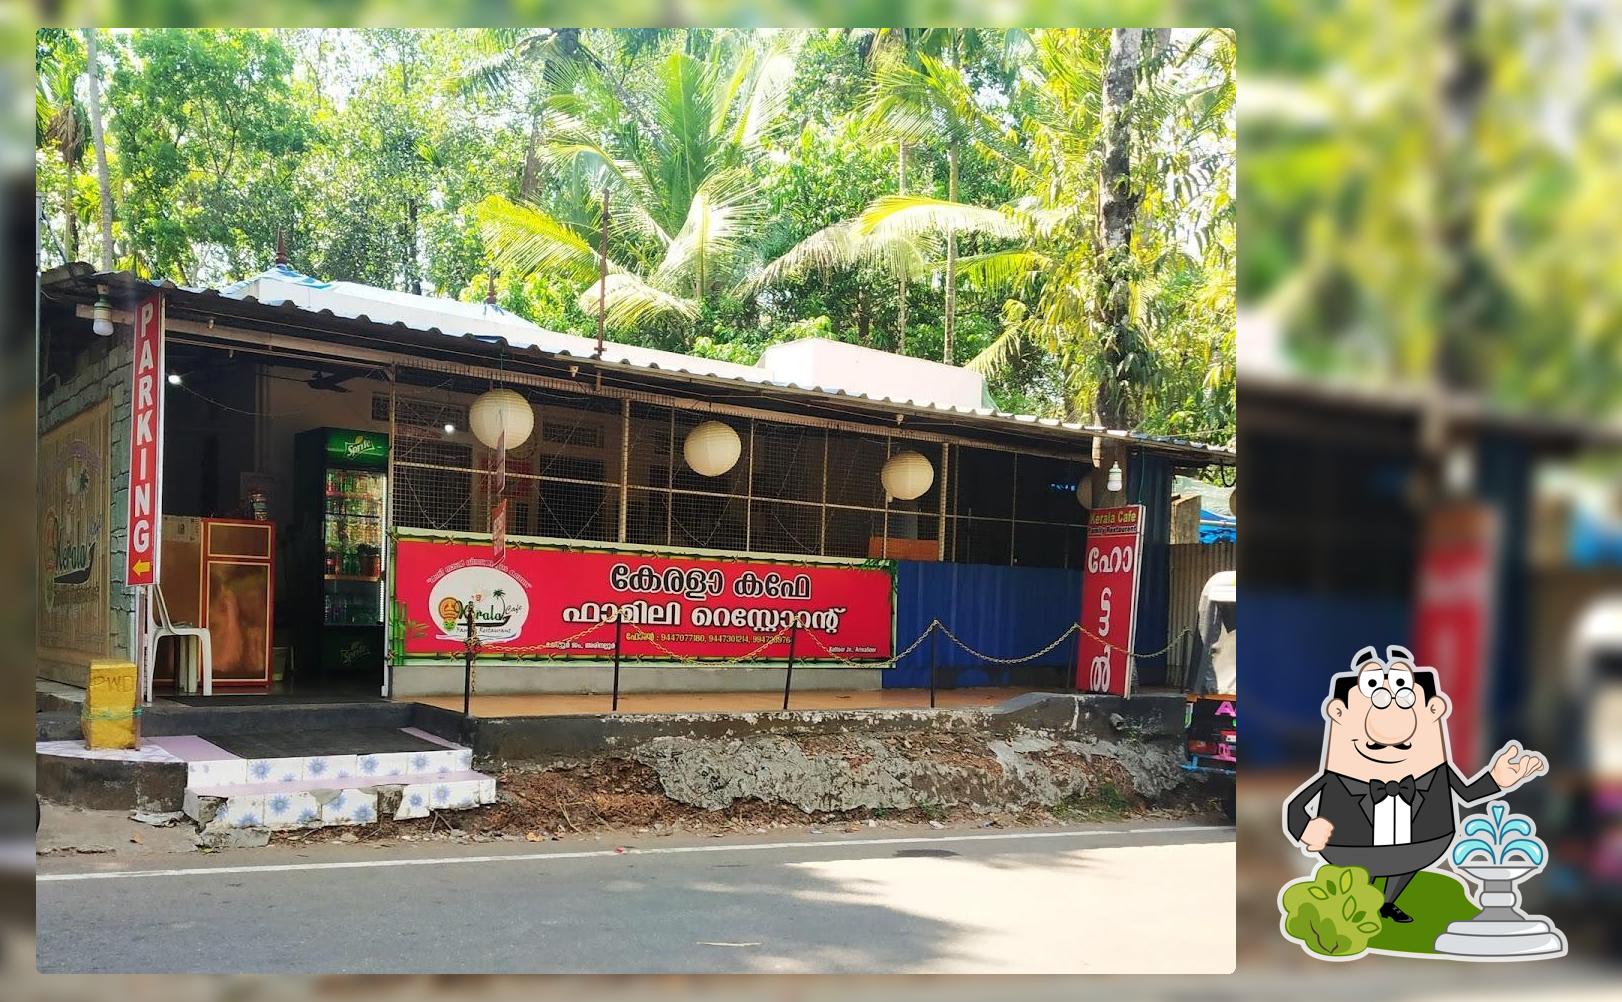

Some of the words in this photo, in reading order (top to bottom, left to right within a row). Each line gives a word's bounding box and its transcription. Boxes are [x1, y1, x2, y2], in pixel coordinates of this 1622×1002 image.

[133, 302, 154, 553] PARKING
[347, 439, 372, 457] Sprite
[1090, 511, 1115, 525] Kerala
[1118, 510, 1137, 523] Cafe
[610, 563, 725, 601] കേരളാ
[733, 571, 811, 600] കഫേ
[456, 600, 504, 621] Krala
[562, 600, 681, 626] ഫാമിലി
[1215, 701, 1236, 717] A
